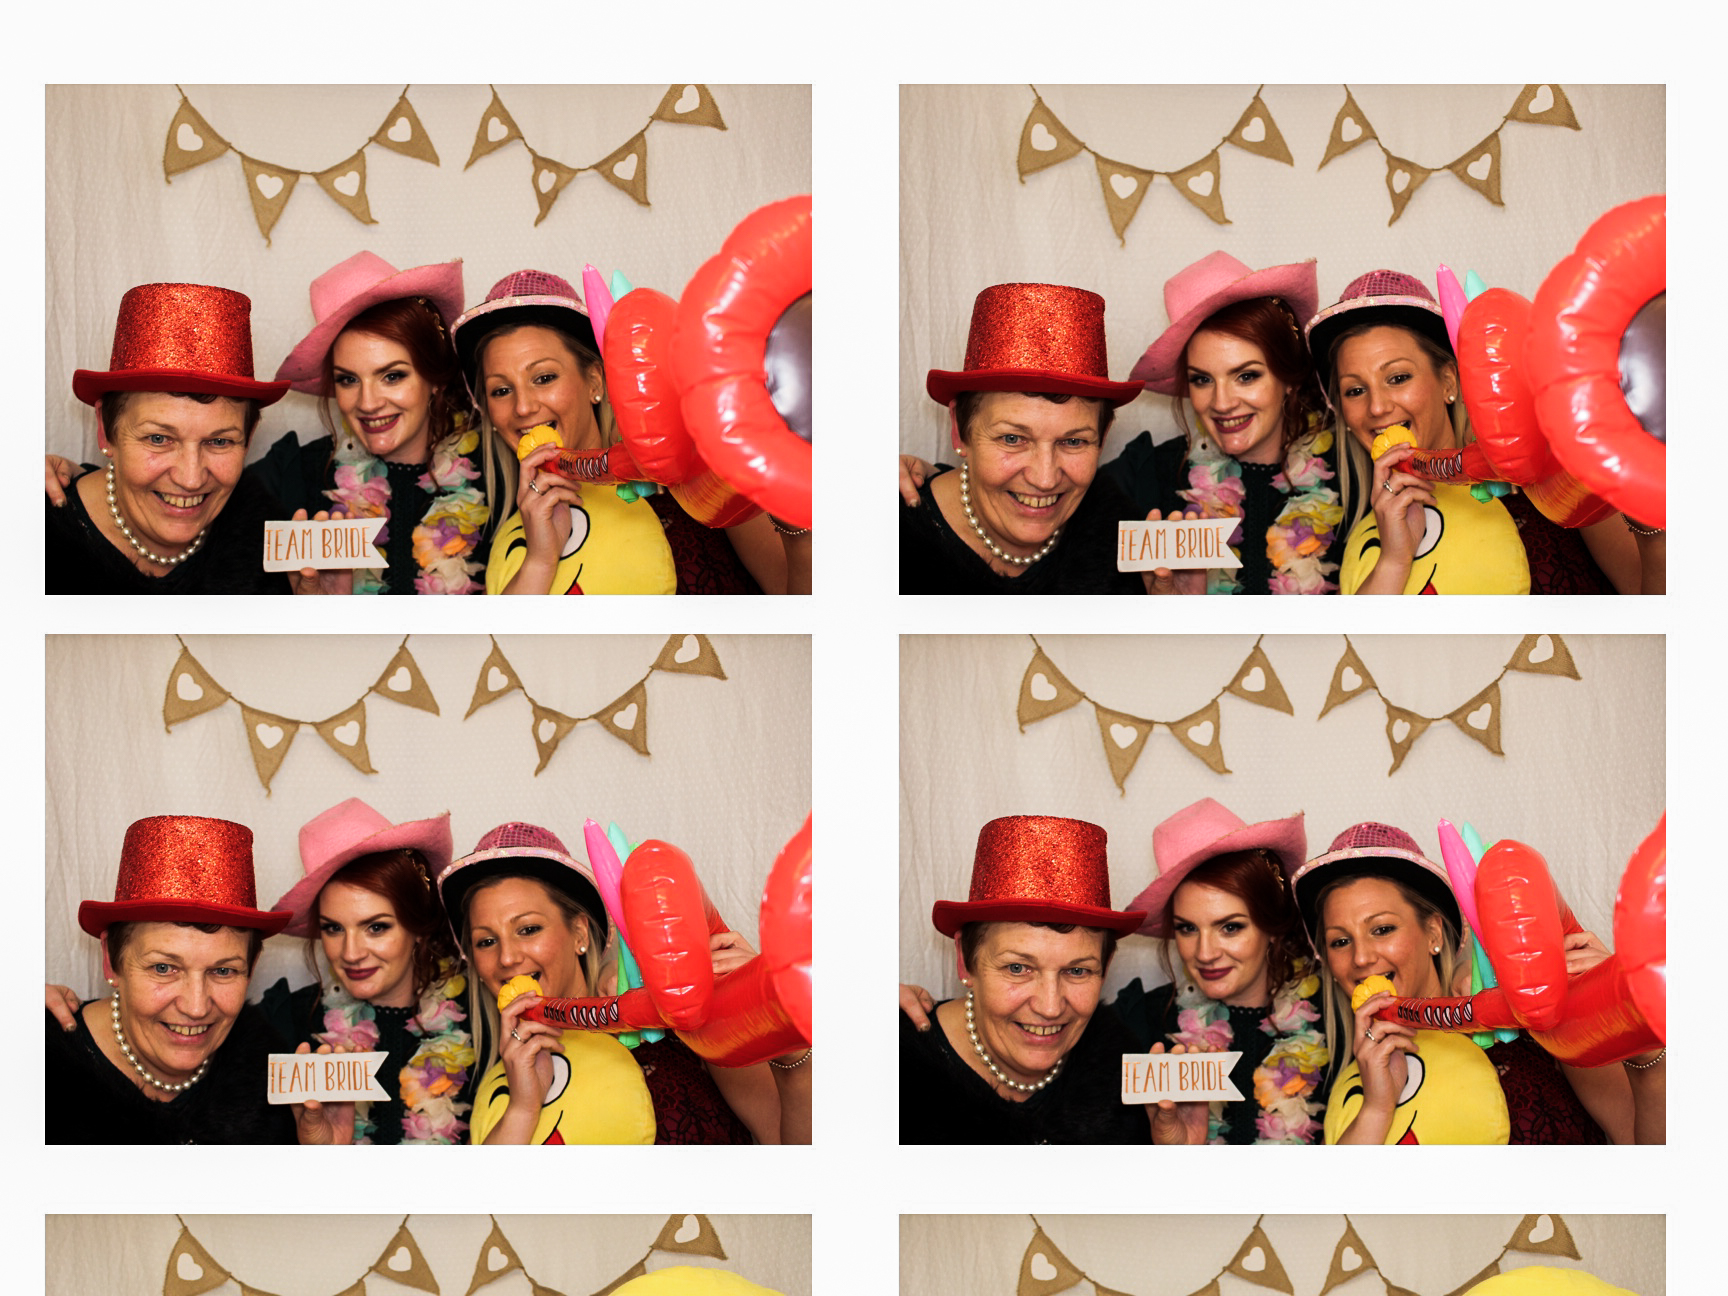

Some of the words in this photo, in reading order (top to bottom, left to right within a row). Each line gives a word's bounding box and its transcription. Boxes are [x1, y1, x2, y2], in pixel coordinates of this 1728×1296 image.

[266, 528, 313, 561] TEAM
[321, 526, 371, 559] BRIDE
[1120, 528, 1167, 561] TEAM
[1175, 526, 1225, 559] BRIDE
[270, 1061, 316, 1094] TEAM
[324, 1060, 373, 1091] BRIDE
[1124, 1061, 1170, 1094] TEAM
[1178, 1060, 1227, 1091] BRIDE
